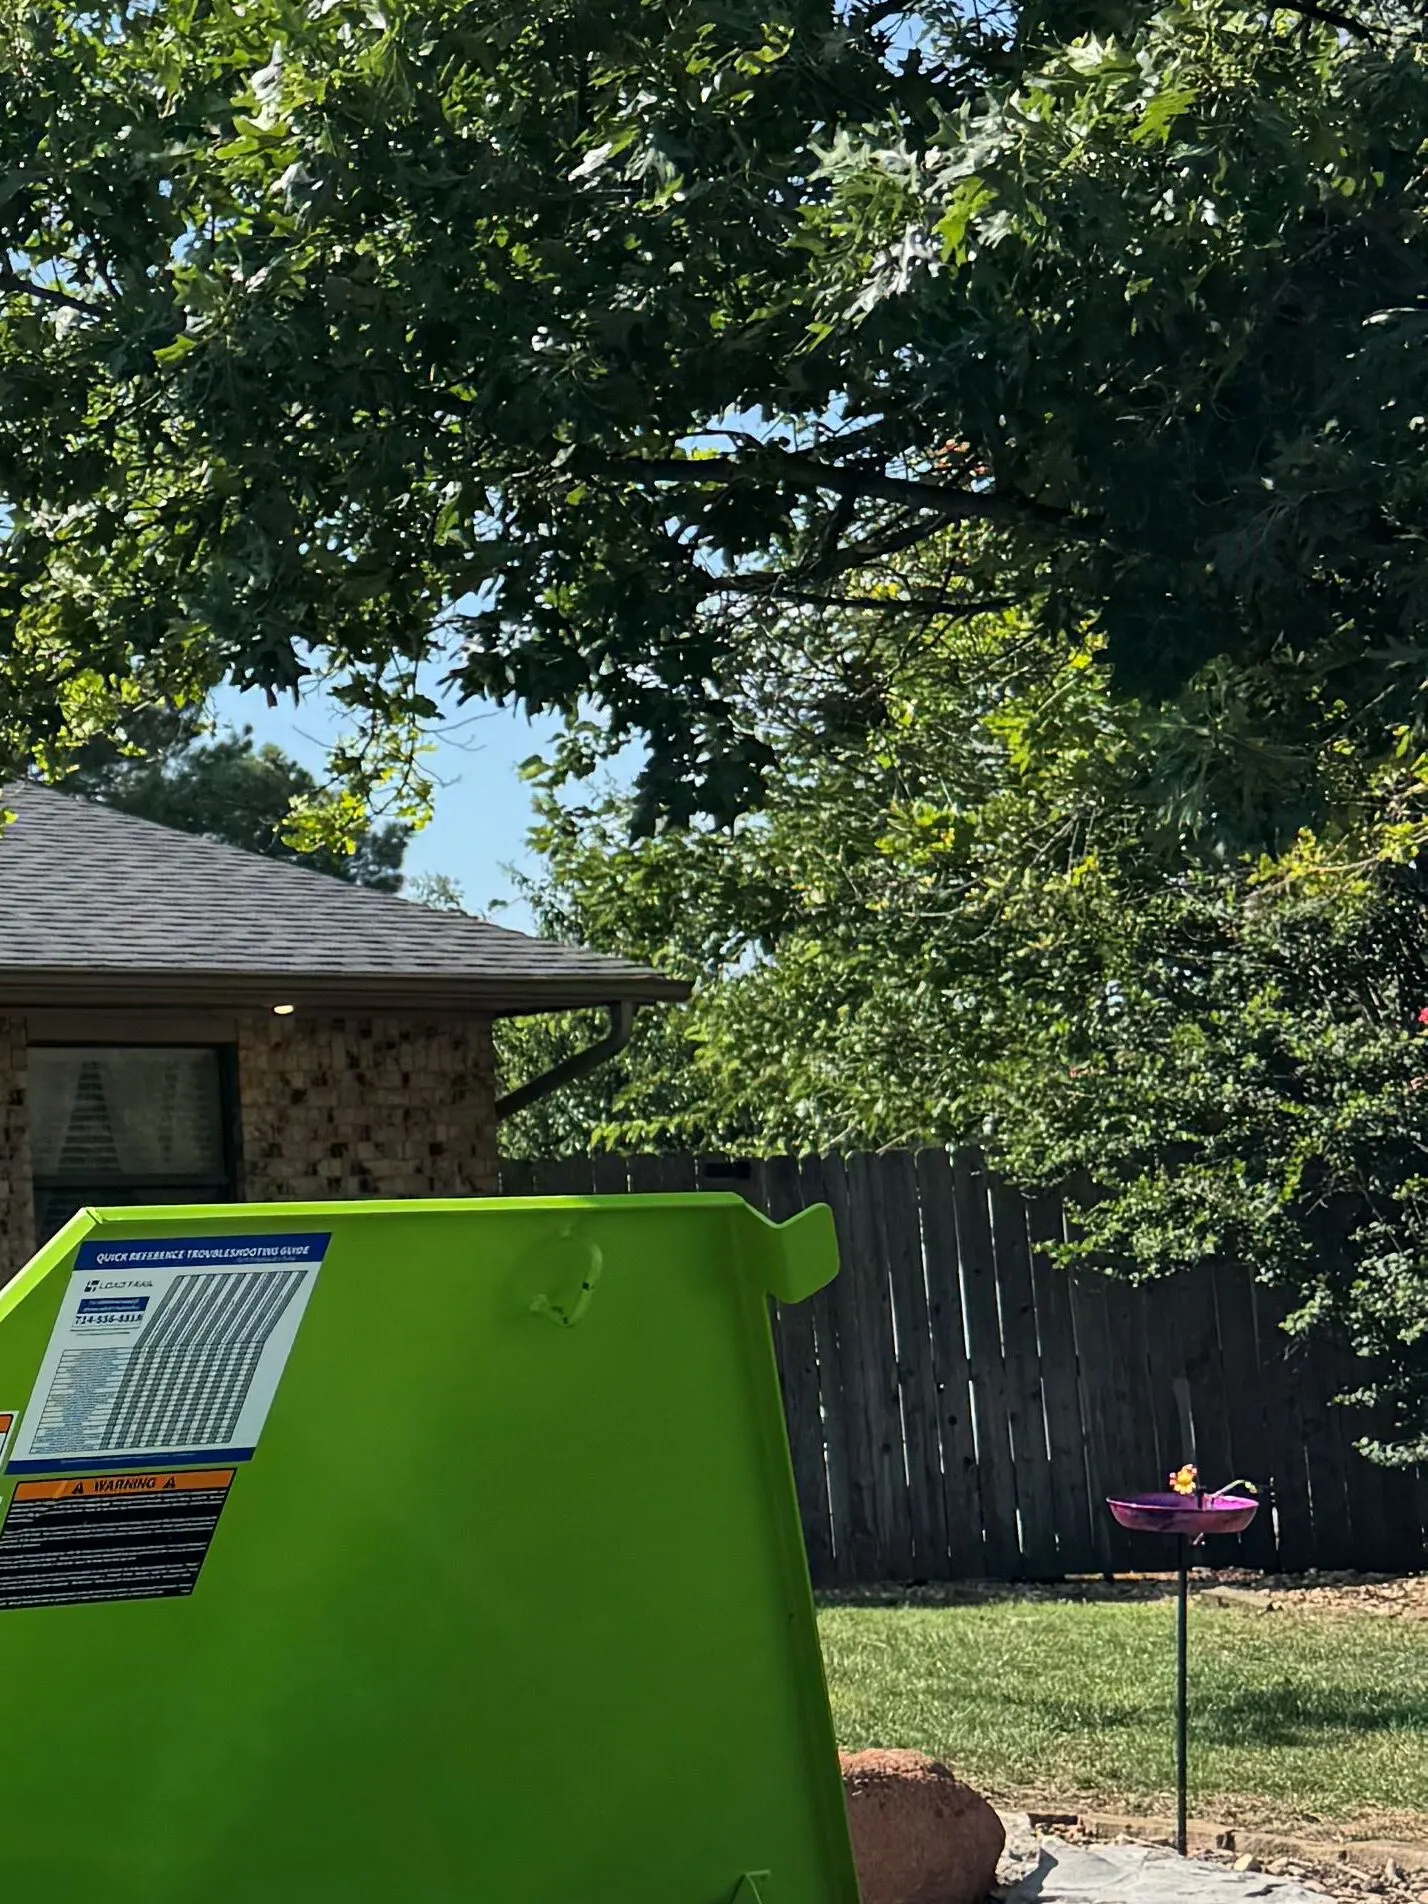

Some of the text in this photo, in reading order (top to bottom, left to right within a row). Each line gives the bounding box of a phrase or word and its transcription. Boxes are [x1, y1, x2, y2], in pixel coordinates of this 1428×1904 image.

[96, 1245, 310, 1264] QUICK REFERENCE TROUBLESHOOTING GUIDE
[94, 1477, 157, 1492] WARNING
